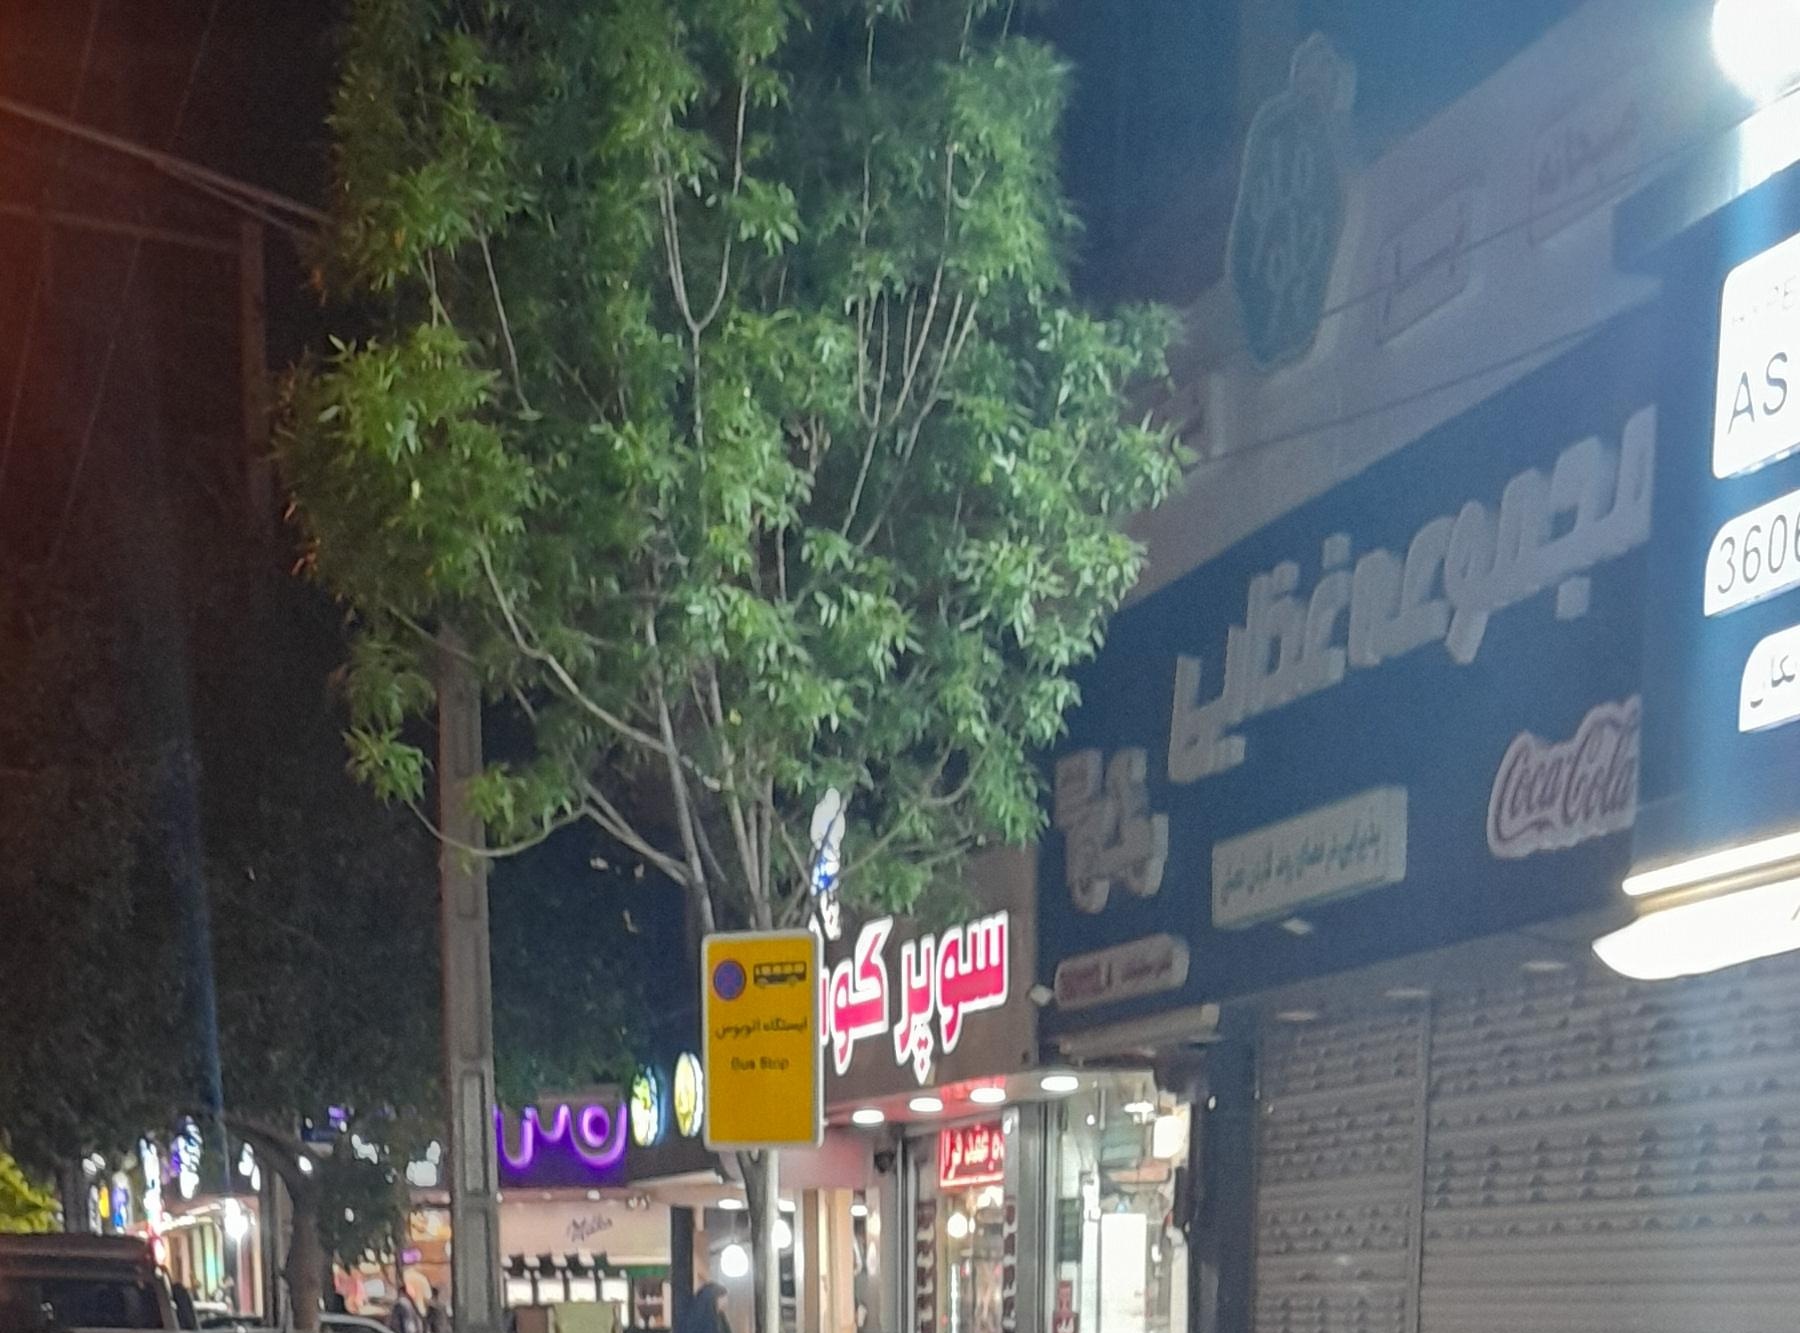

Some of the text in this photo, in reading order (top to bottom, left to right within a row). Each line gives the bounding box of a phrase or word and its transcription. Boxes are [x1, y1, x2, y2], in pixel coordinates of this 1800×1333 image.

[893, 910, 1009, 1086] سوپر
[715, 1016, 808, 1040] ایستگاه اتوبوس
[730, 1056, 790, 1071] Bus Stop
